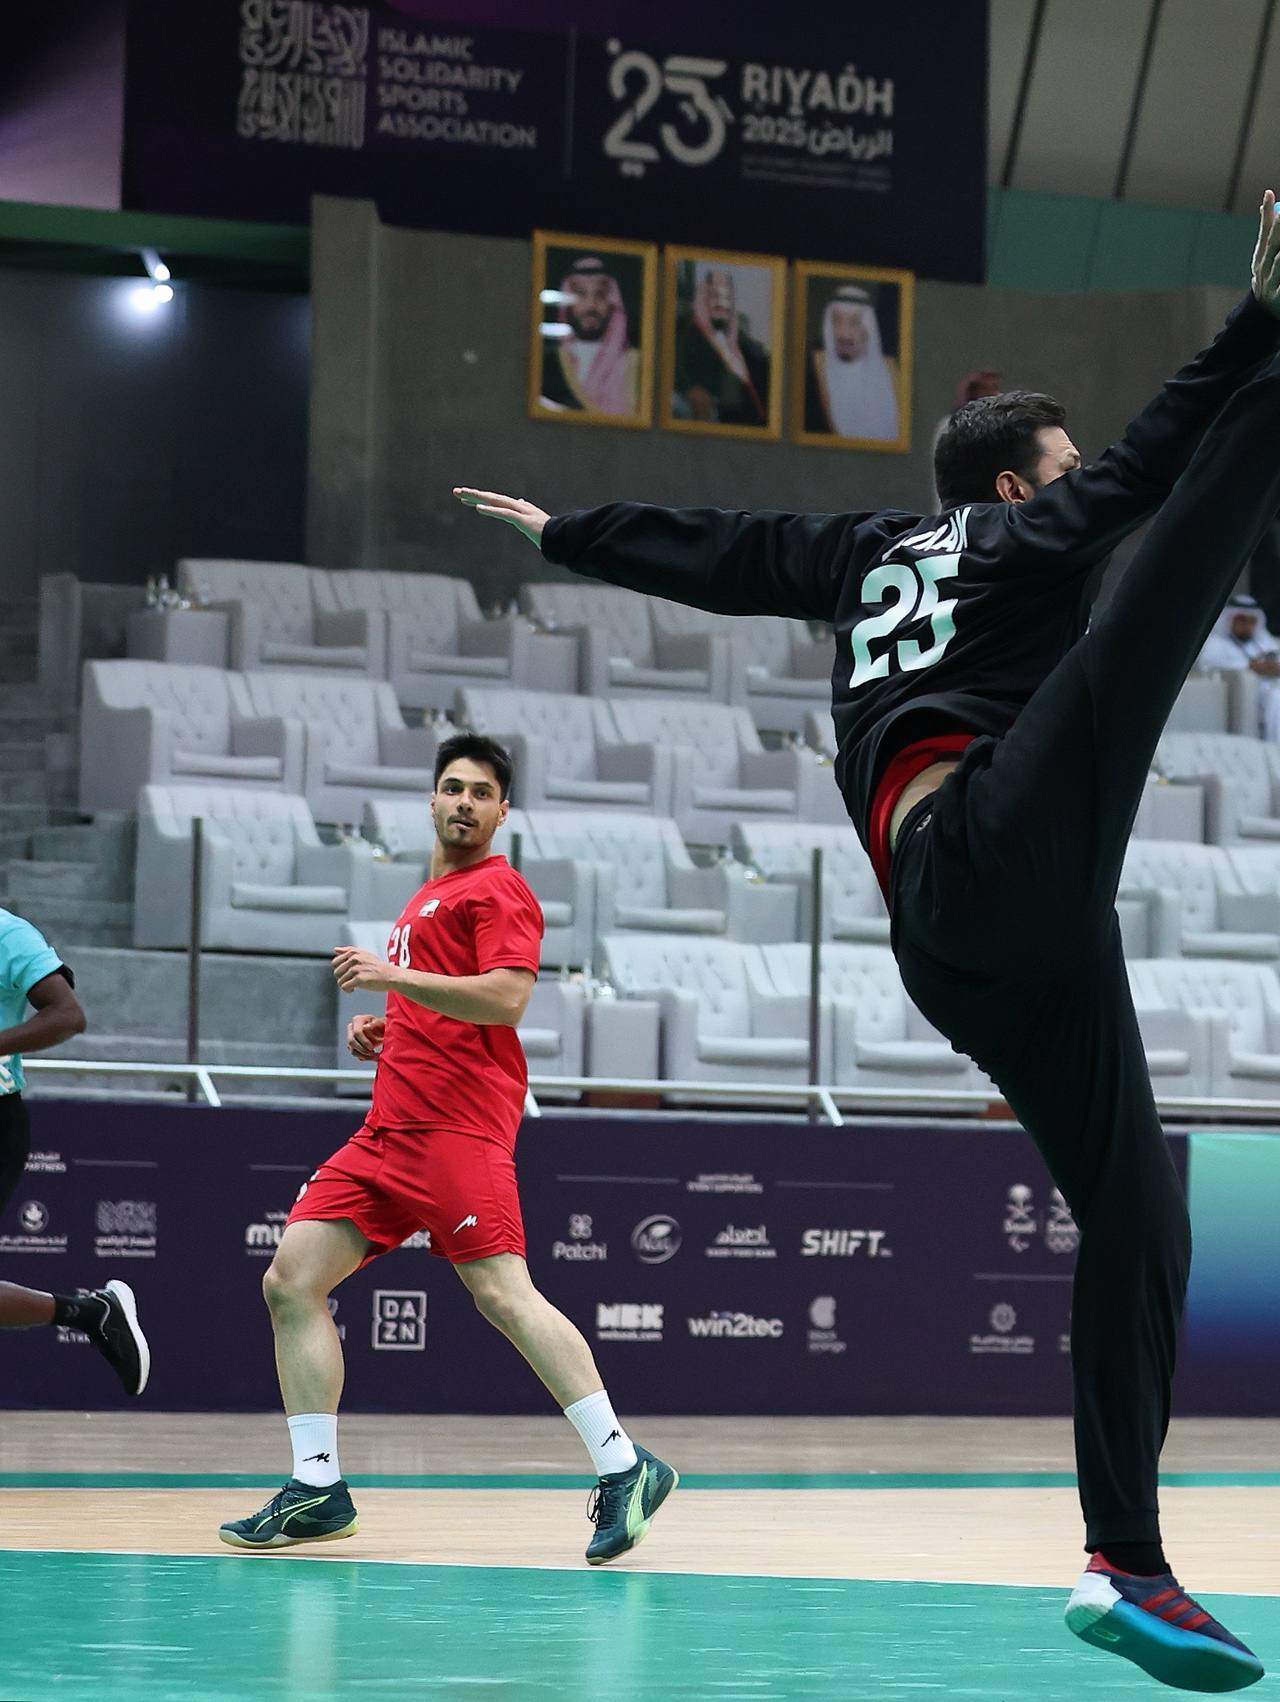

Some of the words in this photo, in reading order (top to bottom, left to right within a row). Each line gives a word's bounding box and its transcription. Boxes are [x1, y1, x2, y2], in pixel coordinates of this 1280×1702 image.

[378, 28, 474, 60] ISLAMIC
[377, 55, 524, 93] SOLIDARITY
[742, 64, 895, 117] RIYADH
[377, 82, 468, 115] SPORTS
[377, 112, 537, 149] ASSOCIATION
[741, 114, 806, 147] 2025
[850, 553, 962, 688] 25
[552, 1241, 608, 1261] Patchi
[801, 1229, 885, 1257] SHIFT
[688, 1311, 784, 1337] win2tec
